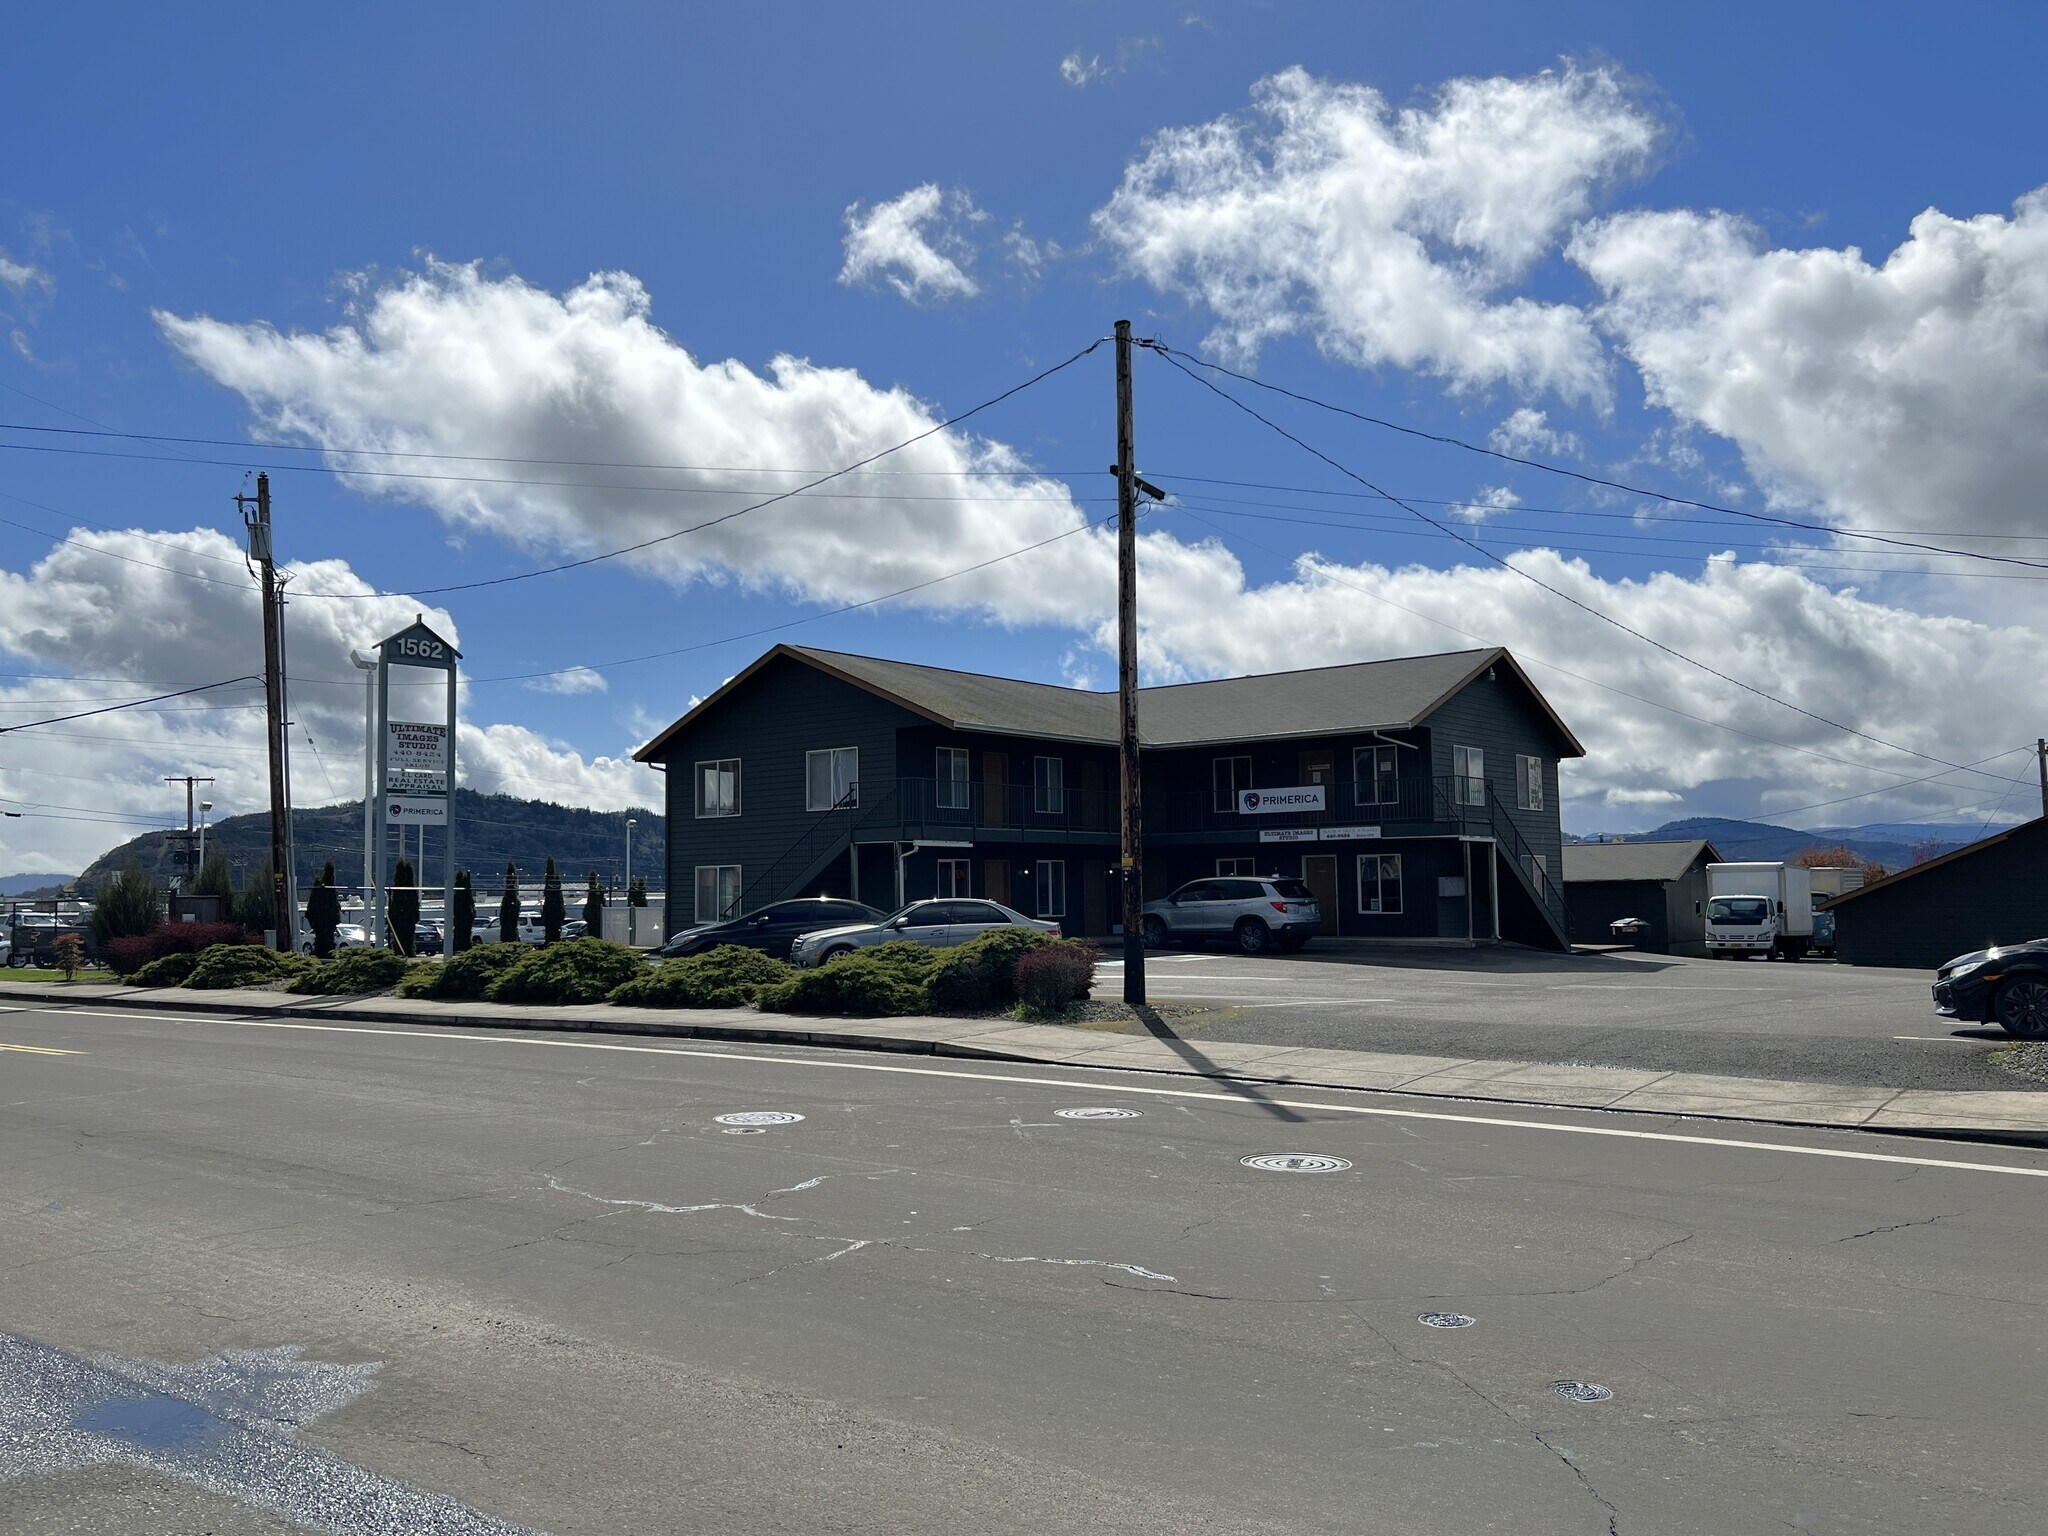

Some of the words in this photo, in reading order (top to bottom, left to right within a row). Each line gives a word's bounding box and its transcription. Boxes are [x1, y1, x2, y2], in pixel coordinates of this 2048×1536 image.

[397, 637, 443, 659] 1562
[390, 724, 446, 738] ULTIMATE
[397, 734, 439, 742] IMAGES
[398, 742, 437, 750] STUDIO
[1262, 793, 1319, 806] PRIMERICA
